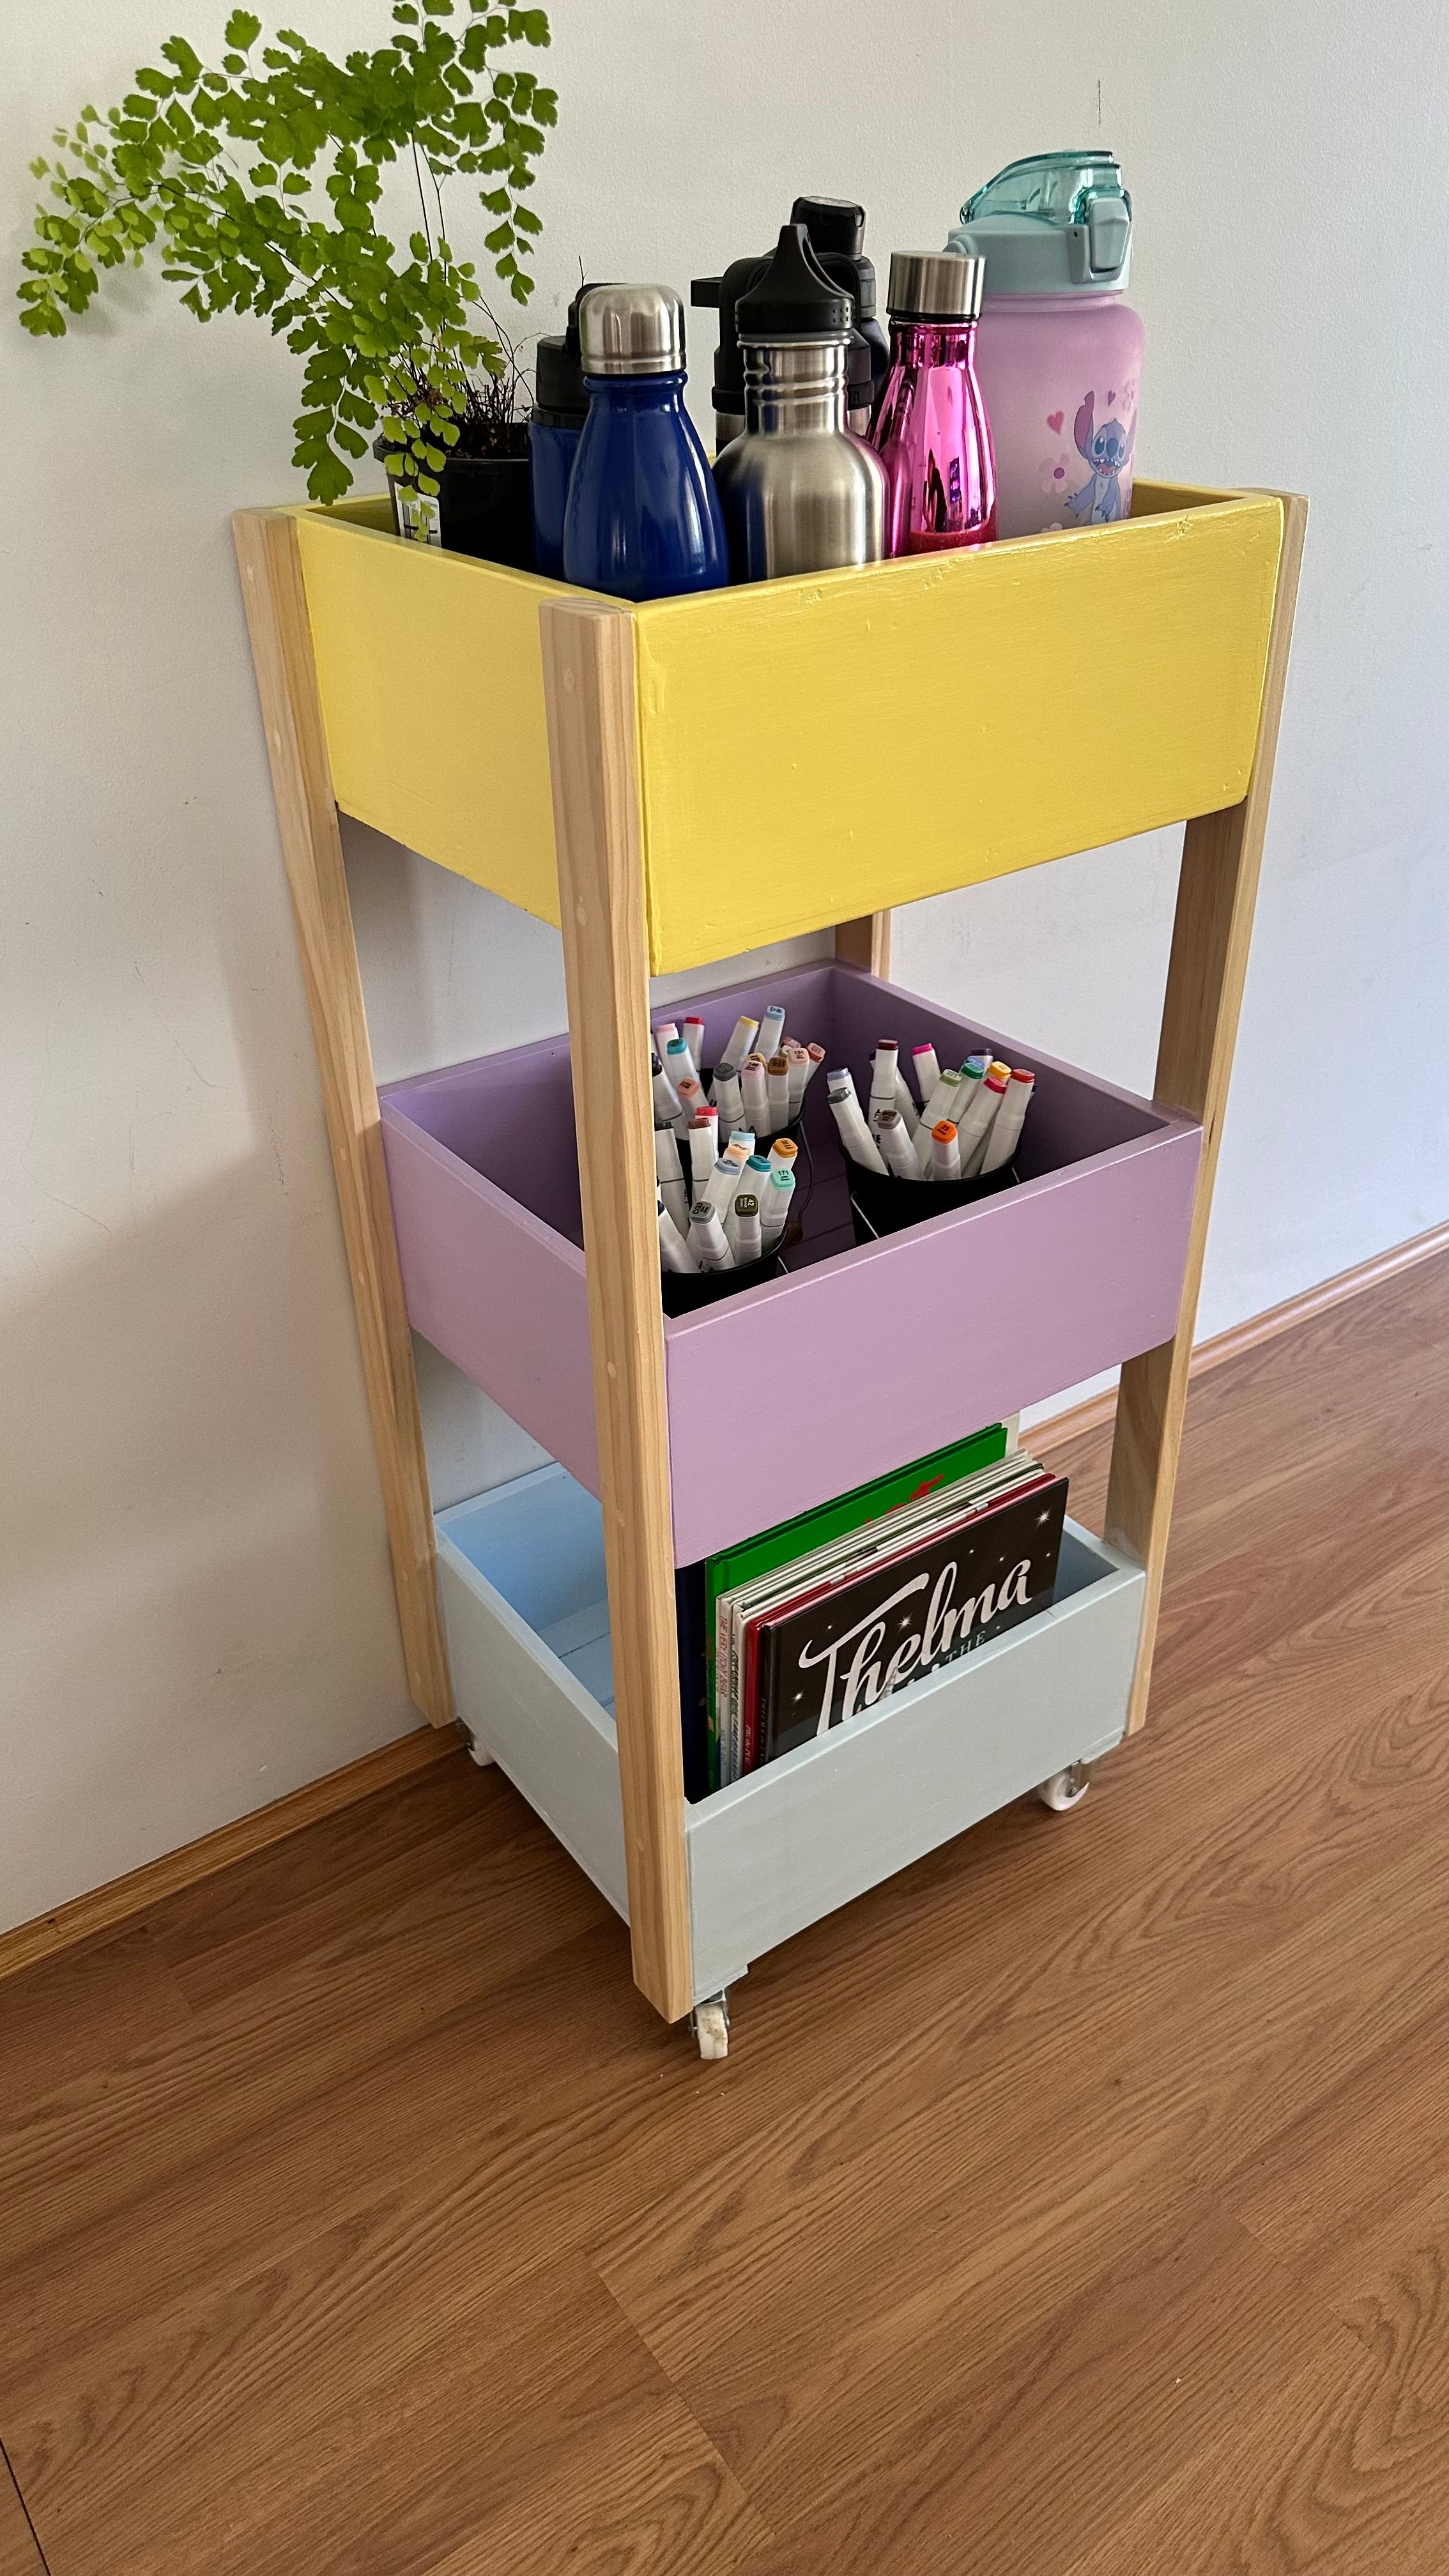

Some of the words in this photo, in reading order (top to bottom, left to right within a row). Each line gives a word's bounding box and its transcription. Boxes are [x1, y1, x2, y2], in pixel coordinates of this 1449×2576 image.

[747, 1199, 755, 1207] 42
[719, 1615, 728, 1632] THE
[719, 1633, 728, 1651] VERY
[799, 1559, 1032, 1736] Thelma
[946, 1630, 986, 1662] THE
